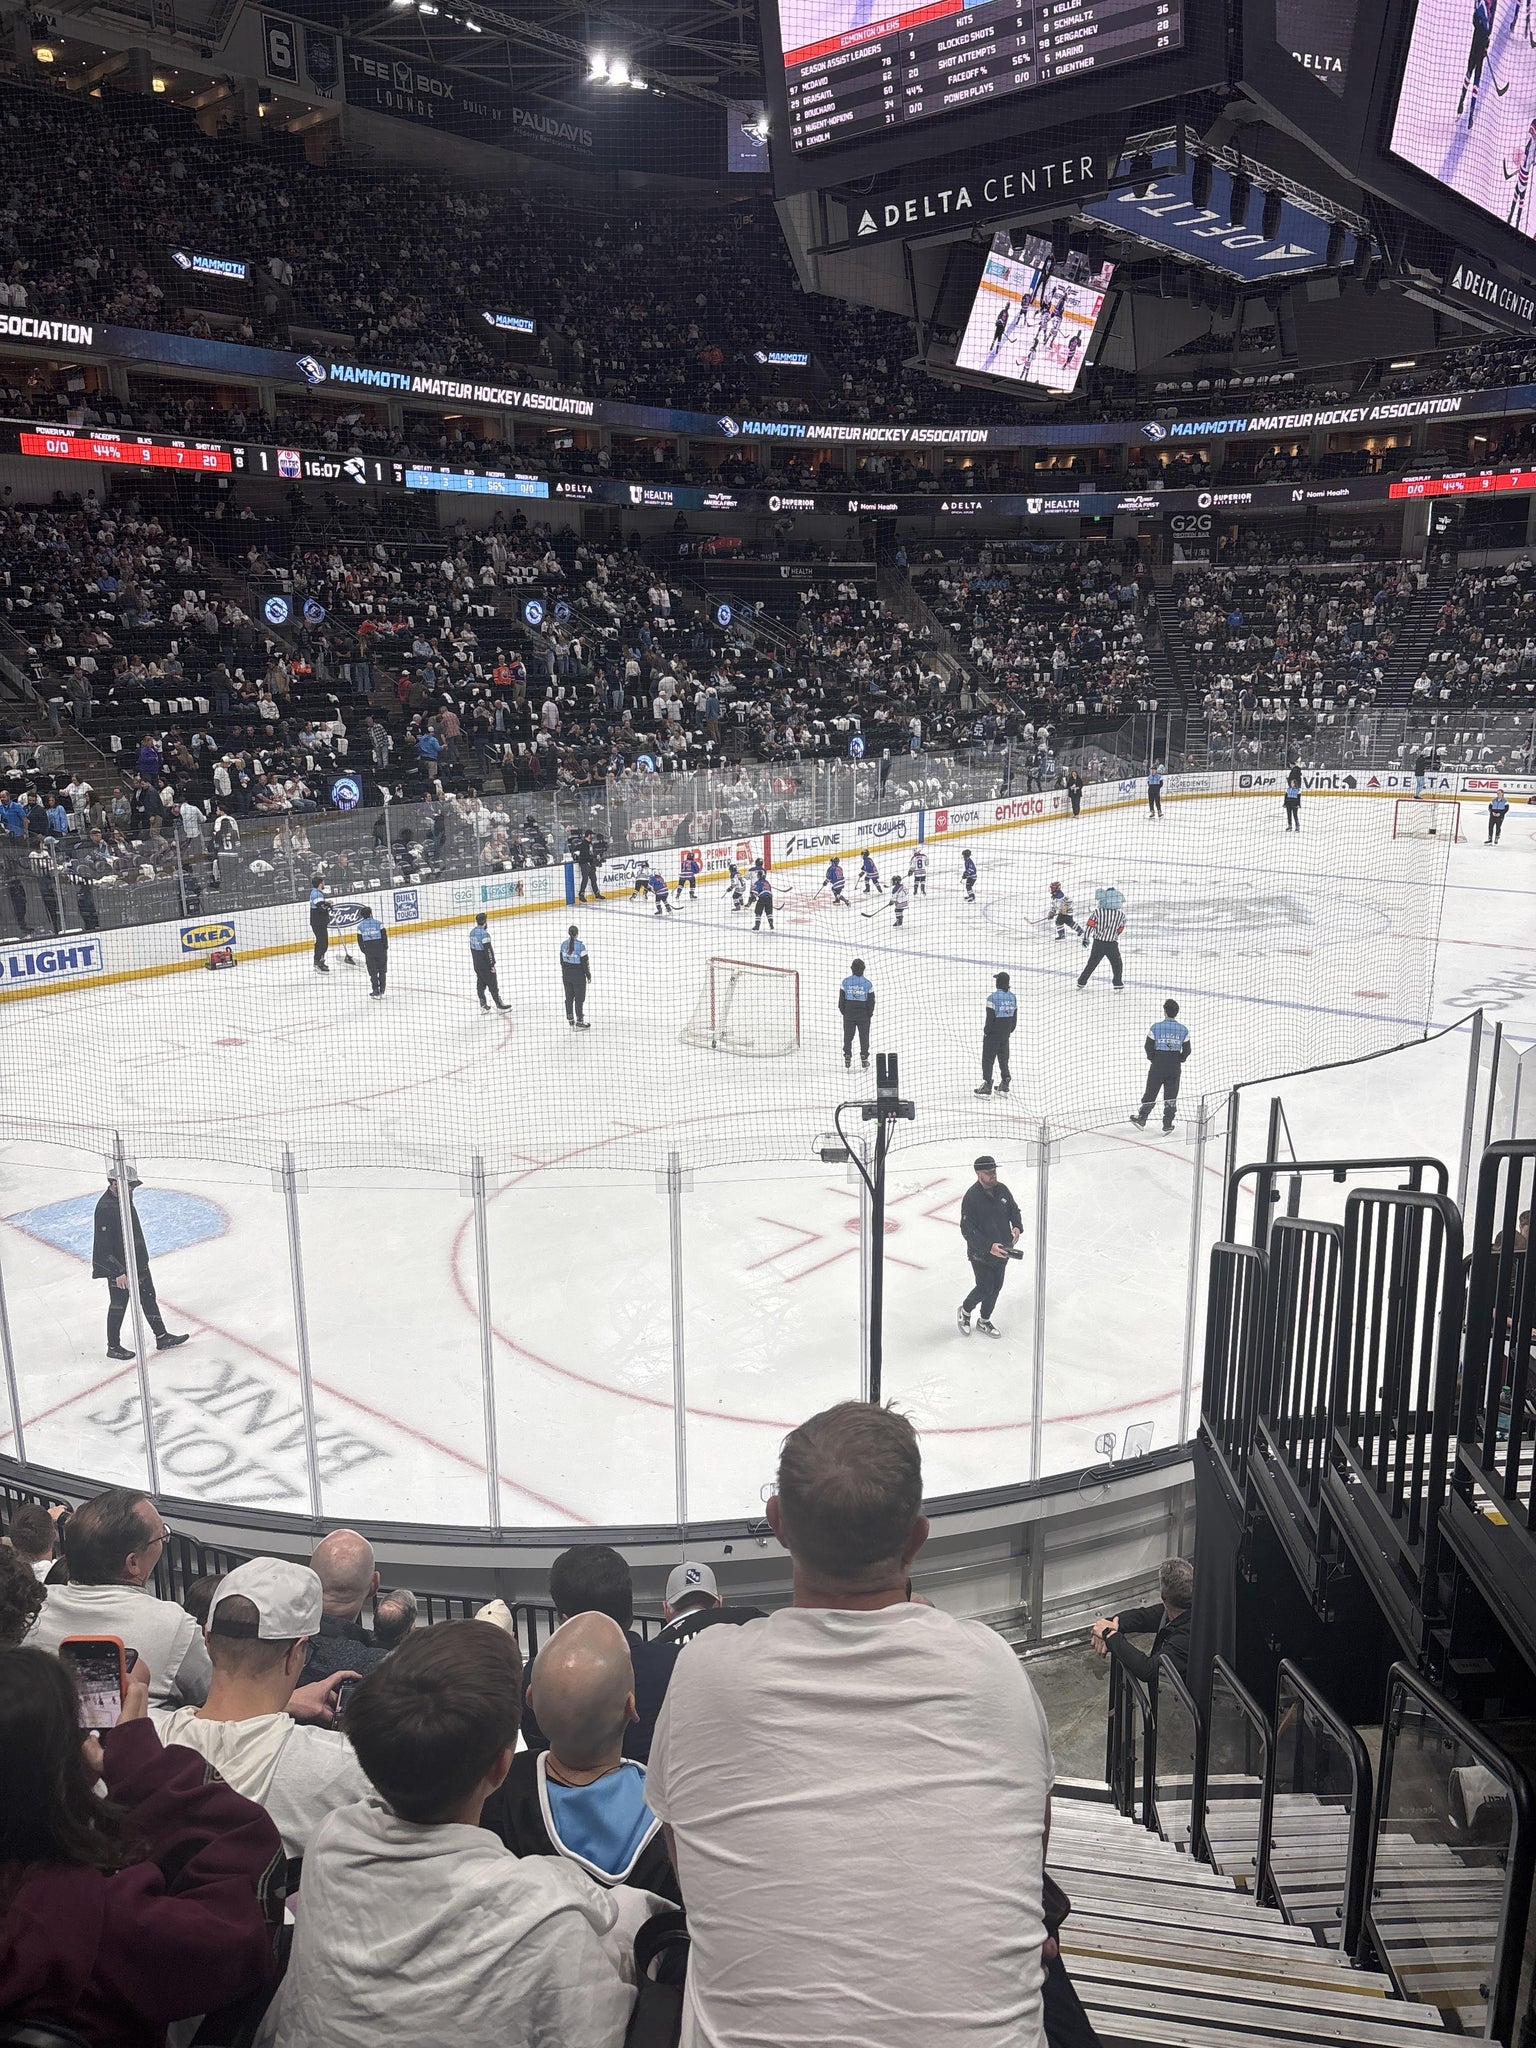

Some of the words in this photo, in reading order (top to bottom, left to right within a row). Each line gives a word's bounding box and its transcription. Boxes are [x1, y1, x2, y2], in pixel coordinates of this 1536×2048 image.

[1043, 8, 1049, 18] 9
[1053, 0, 1082, 14] KELLER
[1156, 4, 1169, 16] 36
[956, 14, 973, 27] HITS
[1016, 18, 1023, 27] 5
[1043, 24, 1049, 33] 8
[1054, 10, 1094, 30] SCHMALTZ
[1157, 20, 1169, 32] 28
[841, 27, 876, 46] EDMONTON
[876, 20, 900, 36] OILERS
[908, 33, 914, 42] 7
[937, 35, 970, 51] BLOCKED
[970, 26, 995, 42] SHOTS
[1039, 39, 1050, 50] 98
[1054, 24, 1099, 45] SERGACHEV
[1157, 36, 1169, 47] 25
[1016, 36, 1026, 46] 13
[270, 29, 291, 69] 6
[909, 51, 916, 60] 9
[1045, 54, 1050, 63] 6
[1055, 44, 1084, 61] MARINO
[800, 61, 826, 77] SEASON
[827, 54, 850, 69] ASSIST
[851, 44, 881, 61] LEADERS
[938, 57, 957, 69] SHOT
[957, 45, 997, 62] ATTEMPTS
[1012, 53, 1031, 66] 56%
[908, 68, 919, 78] 20
[1041, 70, 1050, 79] 11
[1055, 57, 1095, 75] GUENTHER
[350, 54, 390, 81] TEE
[416, 75, 454, 100] BOX
[789, 86, 799, 95] 97
[801, 77, 828, 92] MCDAVID
[881, 57, 891, 67] 78
[947, 68, 980, 85] FACEOFF
[979, 66, 988, 75] %
[1014, 72, 1030, 84] 0/0
[790, 100, 800, 109] 29
[803, 89, 834, 105] DRAISAITL
[882, 71, 892, 81] 62
[906, 85, 923, 96] 44%
[943, 89, 969, 104] POWER
[970, 82, 994, 97] PLAYS
[376, 87, 434, 119] LOUNGE
[463, 100, 487, 117] BUILT
[796, 113, 801, 121] 2
[804, 102, 835, 119] BOUCHARD
[883, 86, 893, 95] 60
[909, 102, 923, 114] 0/0
[793, 127, 802, 136] 93
[805, 112, 853, 132] NUGENT-HOPKINS
[884, 100, 894, 109] 34
[795, 140, 803, 149] 14
[806, 132, 831, 145] EKHOLM
[885, 114, 895, 123] 31
[884, 187, 973, 227] DELTA
[984, 156, 1094, 202] CENTER
[1117, 183, 1274, 250] DELTA
[192, 255, 246, 275] MAMMOTH
[1464, 269, 1499, 304] DELTA
[1499, 288, 1535, 321] CENTER
[495, 314, 534, 330] MAMMOTH
[768, 352, 808, 362] MAMMOTH
[330, 364, 411, 390] MAMMOTH
[411, 376, 472, 400] AMATEUR
[473, 385, 521, 406] HOCKEY
[522, 391, 594, 416] ASSOCIATION
[1170, 418, 1247, 436] MAMMOTH
[1247, 414, 1314, 432] AMATEUR
[1314, 407, 1369, 425] HOCKEY
[1369, 397, 1461, 420] ASSOCIATION
[90, 432, 121, 442] FACEOFFS
[742, 420, 805, 438] MAMMOTH
[806, 425, 861, 440] AMATEUR
[862, 428, 909, 442] HOCKEY
[910, 428, 988, 442] ASSOCIATION
[172, 441, 185, 449] HITS
[195, 443, 210, 451] SHOT
[46, 440, 69, 454] 0/0
[93, 445, 121, 458] 44%
[142, 450, 151, 461] 9
[176, 453, 183, 464] 7
[203, 456, 217, 467] 20
[235, 457, 244, 468] 8
[259, 452, 268, 471] 1
[304, 462, 341, 478] 16:07
[374, 463, 382, 481] 1
[395, 472, 402, 482] 3
[442, 478, 449, 487] 3
[467, 480, 473, 489] 5
[487, 481, 506, 492] 56%
[1443, 482, 1464, 491] 44%
[1482, 480, 1489, 488] 9
[1511, 477, 1518, 486] 7
[565, 484, 593, 494] DELTA
[644, 490, 673, 501] HEALTH
[1306, 491, 1325, 499] Nomi
[1326, 489, 1350, 497] Health
[1407, 485, 1424, 494] 0/0
[782, 498, 815, 506] SUPERIOR
[1044, 500, 1080, 509] HEALTH
[1213, 493, 1252, 502] SUPERIOR
[860, 503, 876, 511] Nomi
[877, 503, 898, 511] Health
[951, 502, 982, 510] DELTA
[1171, 514, 1212, 531] G2G
[1046, 762, 1055, 772] 70
[1169, 780, 1208, 790] INGREDIENTS
[1388, 776, 1450, 789] DETA
[1468, 781, 1499, 789] SME
[995, 799, 1044, 821] entrata
[950, 811, 980, 825] TOYOTA
[797, 834, 841, 850] FILEVINE
[706, 847, 732, 859] PEANUT
[706, 859, 732, 871] BETTER
[532, 879, 548, 889] G2G
[602, 873, 638, 884] AMERICA
[396, 893, 416, 903] BUILT
[454, 890, 472, 900] G2G
[327, 905, 361, 926] Ford
[397, 911, 417, 919] TOUGH
[186, 929, 232, 943] IKEA
[9, 945, 96, 978] LIGHT
[167, 1358, 394, 1485] BANK
[86, 1394, 307, 1503] ZIONS
